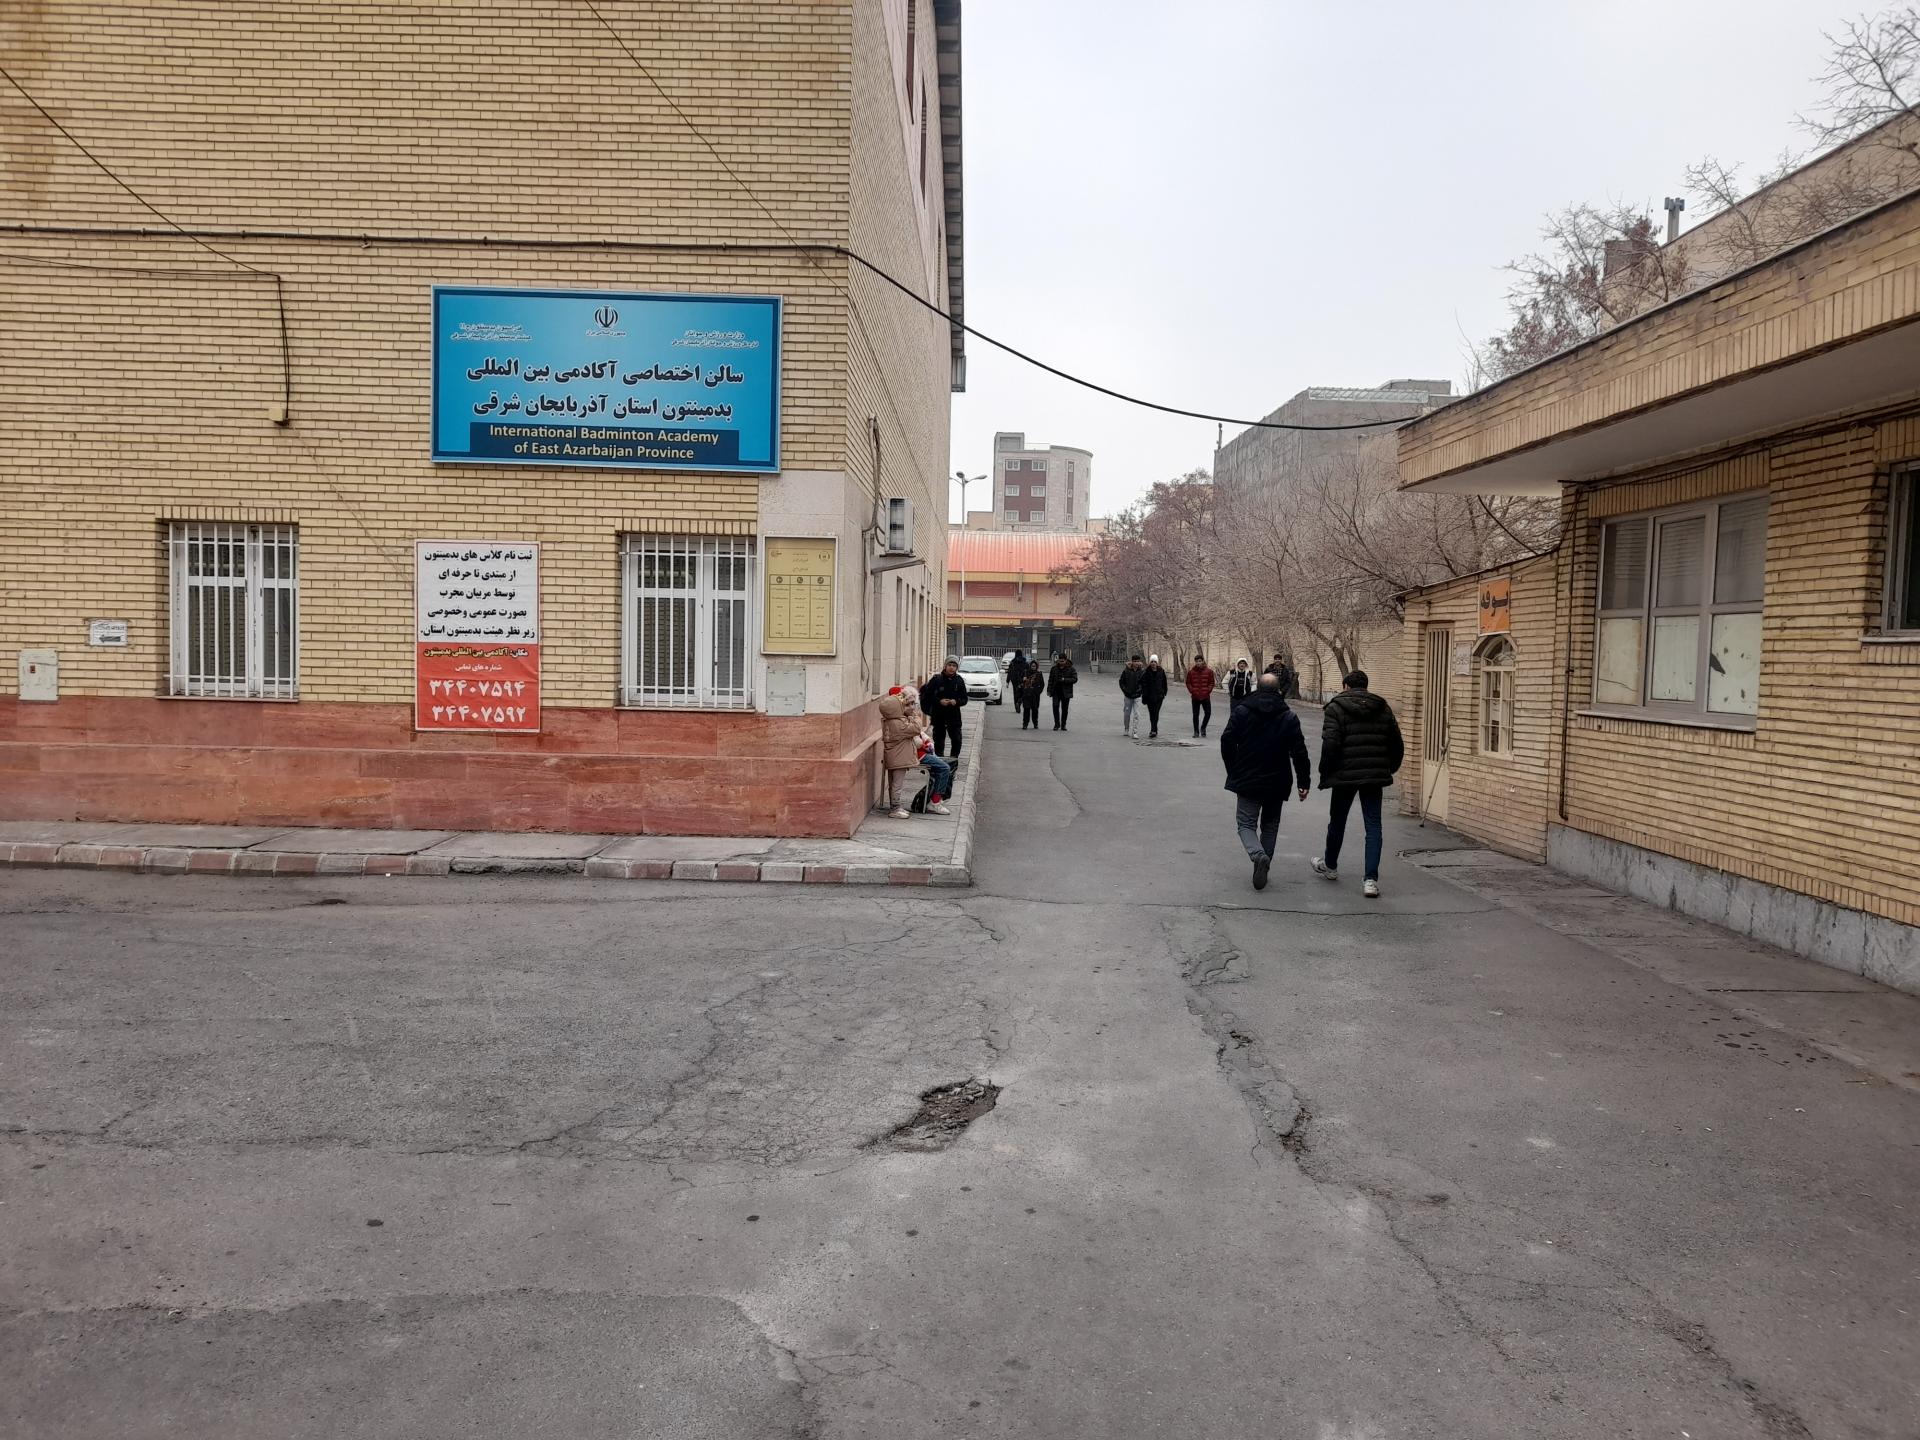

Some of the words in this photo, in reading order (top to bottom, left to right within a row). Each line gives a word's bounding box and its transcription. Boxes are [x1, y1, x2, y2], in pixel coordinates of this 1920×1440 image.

[467, 358, 519, 380] المللی
[523, 364, 550, 381] بین
[554, 360, 618, 383] آکادمی
[622, 363, 700, 386] اختصاصی
[704, 364, 744, 387] سالن
[473, 391, 521, 416] شرقی
[525, 394, 608, 418] آذربایجان
[613, 397, 658, 419] استان
[662, 401, 732, 421] بدمینتون
[490, 424, 577, 439] International
[580, 427, 654, 441] Badminton
[657, 429, 719, 445] Academy
[514, 441, 529, 454] of
[532, 443, 559, 455] East
[562, 443, 633, 459] Azarbaijan
[637, 445, 694, 459] Province
[424, 550, 459, 561] بدمینتون
[460, 549, 478, 561] های
[479, 549, 502, 562] کلاس
[504, 550, 516, 562] نام
[517, 550, 533, 562] ثبت
[438, 568, 450, 580] ای
[451, 567, 472, 580] حرفه
[473, 568, 480, 578] تا
[481, 569, 507, 581] مبتدی
[508, 570, 516, 581] از
[440, 588, 464, 599] مجرب
[465, 588, 491, 600] مربیان
[493, 588, 516, 600] توسط
[1480, 584, 1509, 617] بوفه
[469, 608, 497, 619] عمومی
[498, 607, 527, 619] بصورت
[446, 626, 481, 637] بدمینتون
[505, 626, 521, 638] نظر
[522, 627, 535, 638] زیر
[452, 646, 472, 657] المللی
[484, 647, 509, 658] آکادمی
[429, 680, 526, 697] ۳۴۴۰۷۵۹۴
[431, 704, 526, 723] ۳۴۴۰۷۵۹۲
